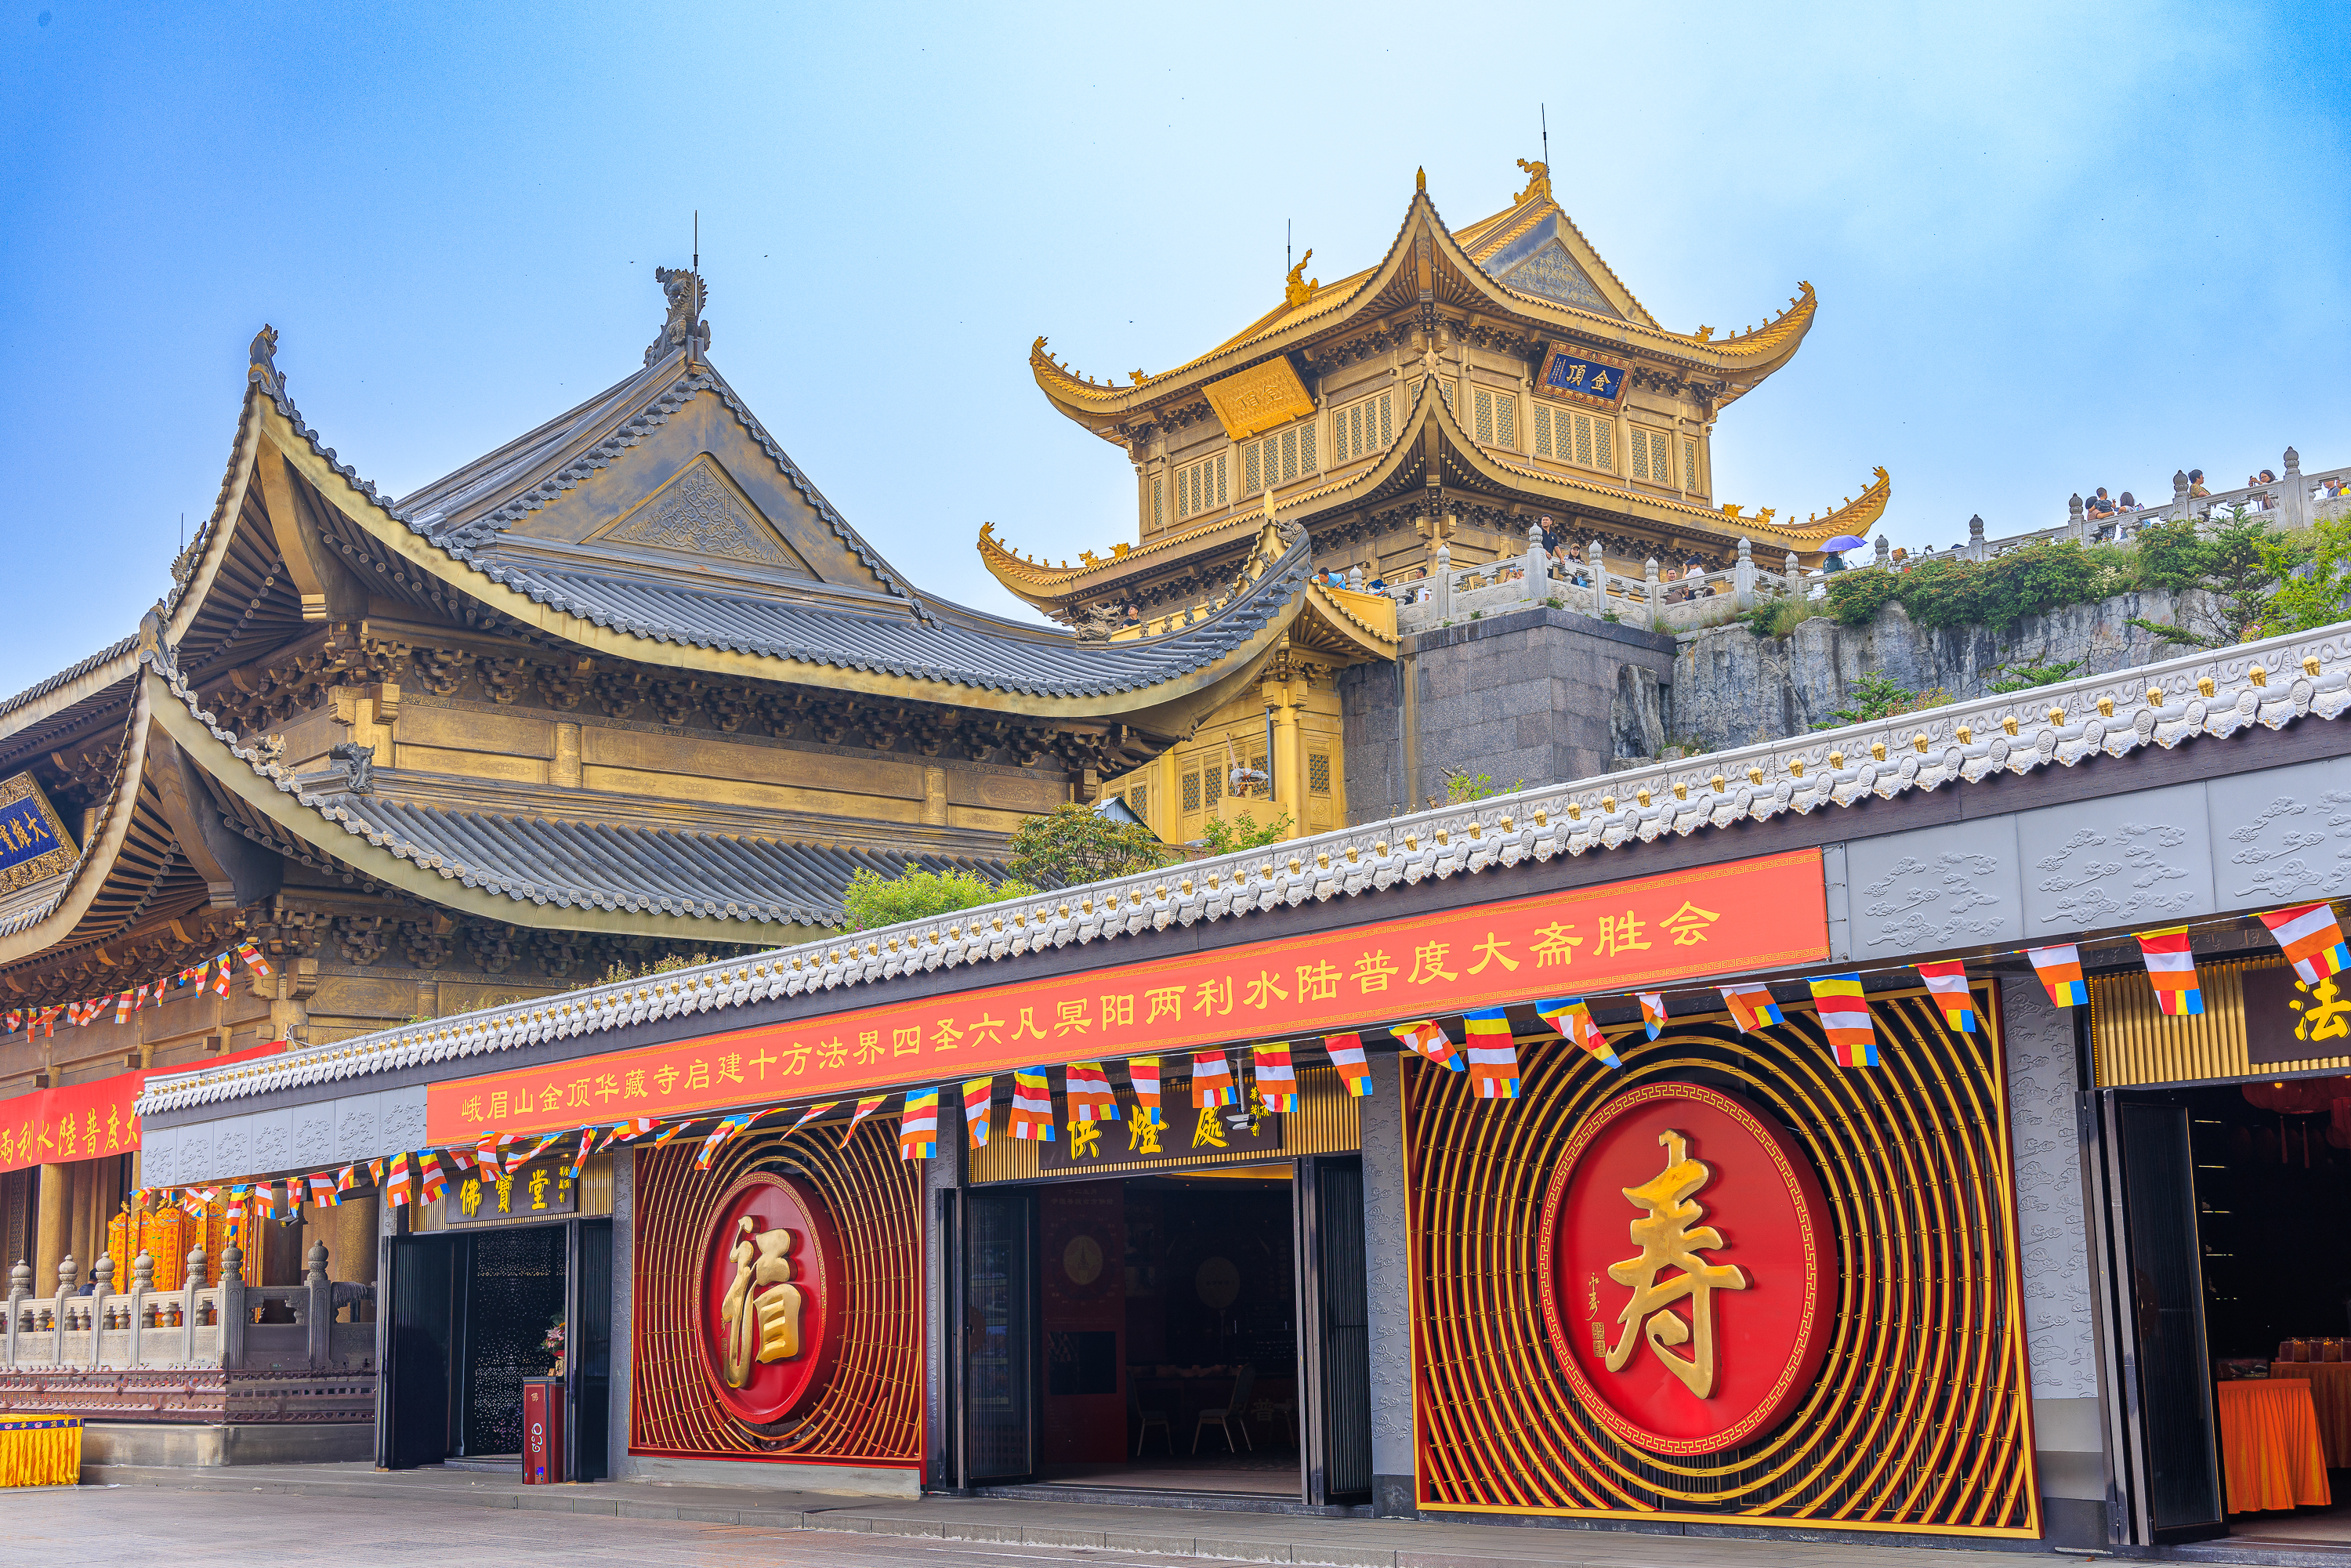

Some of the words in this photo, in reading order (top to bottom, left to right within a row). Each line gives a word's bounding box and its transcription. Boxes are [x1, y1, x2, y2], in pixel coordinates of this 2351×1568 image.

[1236, 385, 1283, 411] 金頂
[1566, 364, 1611, 392] 金頂
[0, 811, 49, 856] 大雄寶
[462, 900, 1721, 1123] 峨眉山金顶华藏寺启建十方法界四圣六凡冥阳两利水陆普度大斋胜会
[2289, 976, 2351, 1042] 法
[460, 1169, 551, 1218] 佛寶堂
[113, 1232, 125, 1293] 南無本師釋迦牟尼
[208, 1222, 217, 1287] 南無本師釋迦牟尼
[1607, 1128, 1748, 1400] 寿
[722, 1215, 804, 1389] 福
